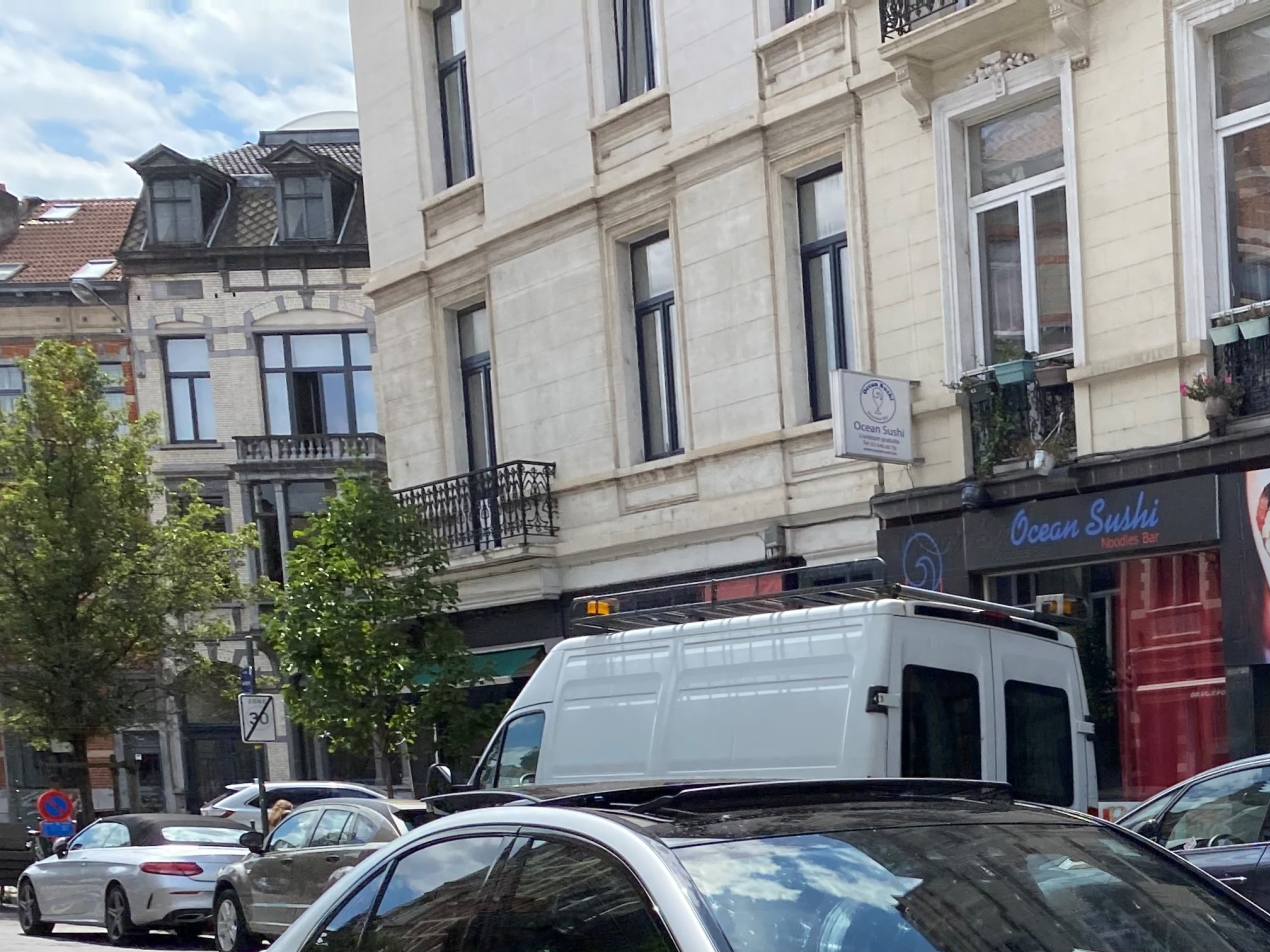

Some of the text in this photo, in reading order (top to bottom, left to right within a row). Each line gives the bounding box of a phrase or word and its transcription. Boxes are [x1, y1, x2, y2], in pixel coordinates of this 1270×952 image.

[853, 421, 904, 437] Ocean Sushi
[1010, 491, 1159, 546] Ocean Sushi
[1101, 531, 1160, 549] Noodles Bar
[249, 712, 269, 725] 30
